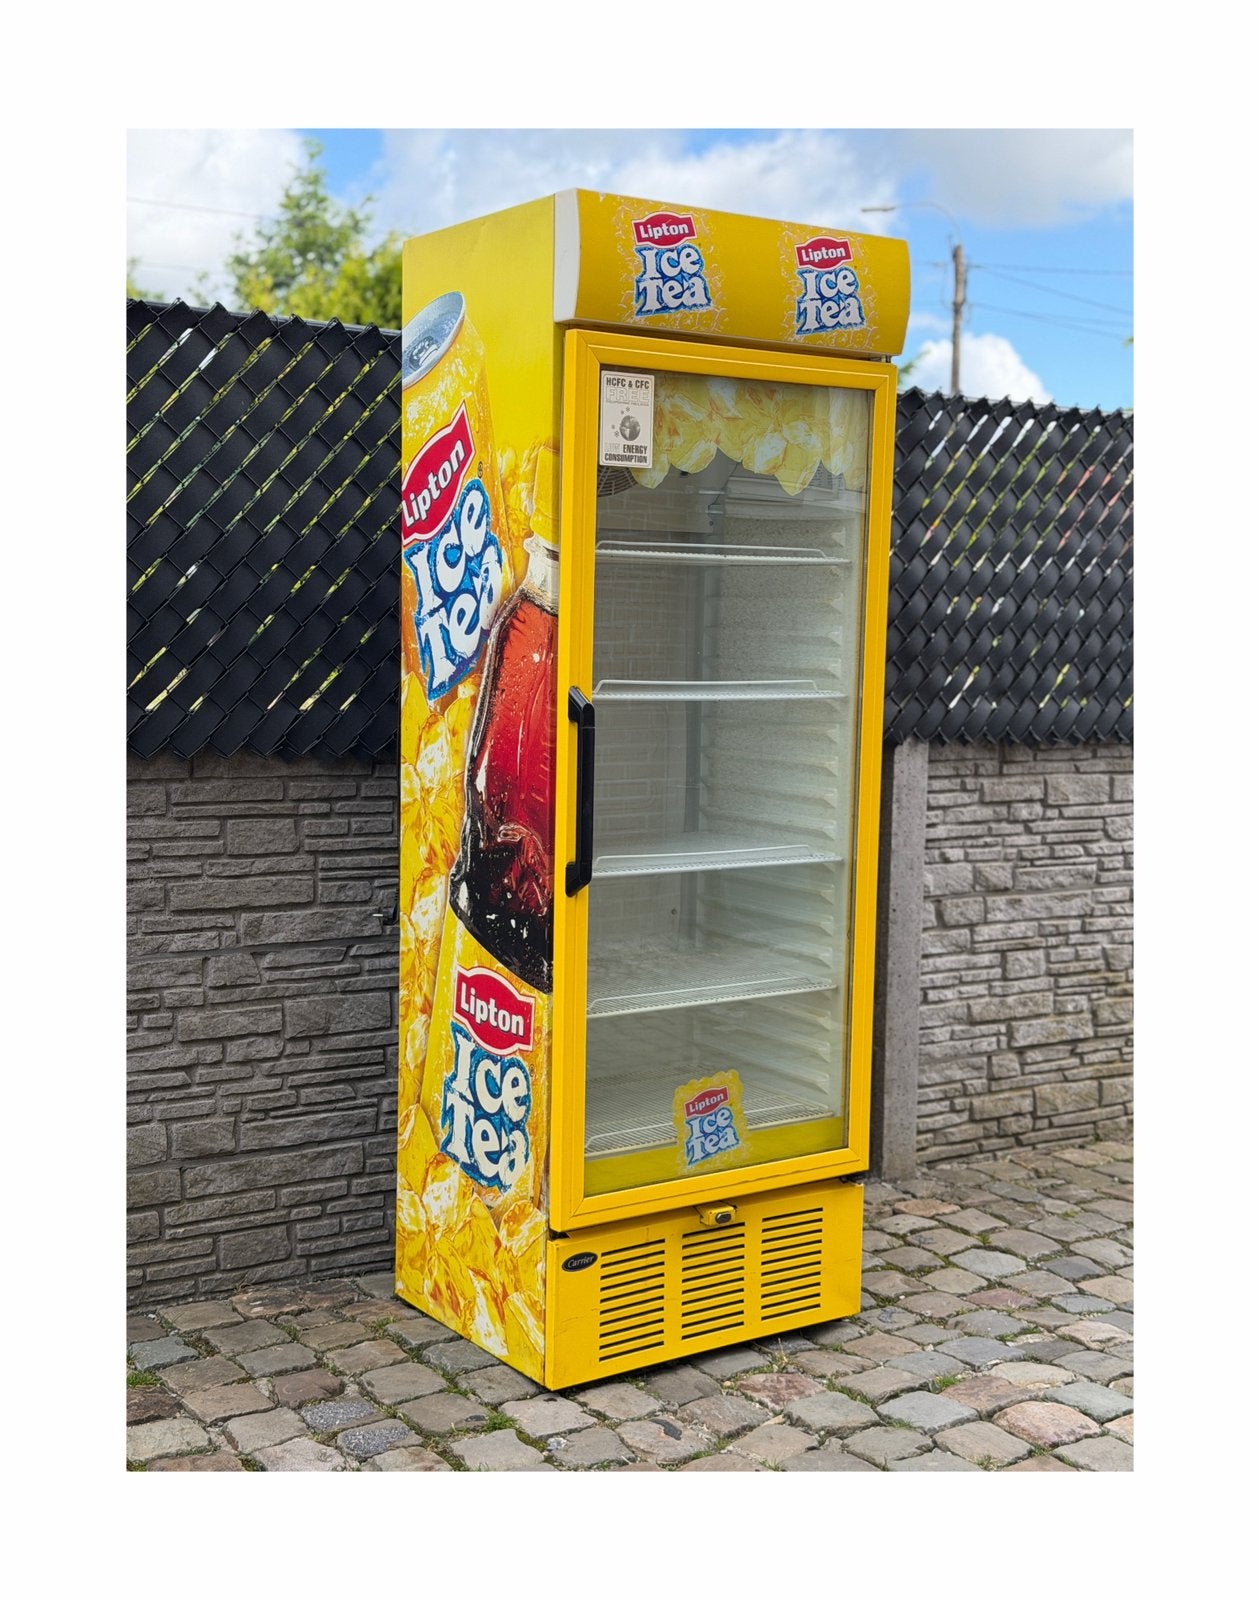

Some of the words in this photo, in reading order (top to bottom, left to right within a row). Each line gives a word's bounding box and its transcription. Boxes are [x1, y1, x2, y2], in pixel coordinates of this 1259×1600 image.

[639, 223, 690, 239] Lipton
[640, 247, 700, 279] Ice
[801, 247, 846, 262] Lipton
[639, 278, 706, 312] Tea
[801, 269, 856, 299] Ice
[801, 296, 862, 330] Tea
[606, 377, 626, 388] HCFC
[628, 380, 632, 388] &
[635, 380, 650, 390] CFC
[604, 453, 648, 463] CONSUMPTION
[623, 444, 648, 455] ENERGY
[402, 439, 465, 528] Lipton
[410, 489, 488, 614] Ice
[418, 545, 502, 690] Tea
[460, 982, 525, 1037] Lipton
[454, 1031, 529, 1123] Ice
[689, 1093, 724, 1112] Lipton
[690, 1108, 730, 1138] Ice
[446, 1093, 528, 1187] Tea
[687, 1126, 738, 1163] Tea
[568, 1254, 594, 1268] Carrier
